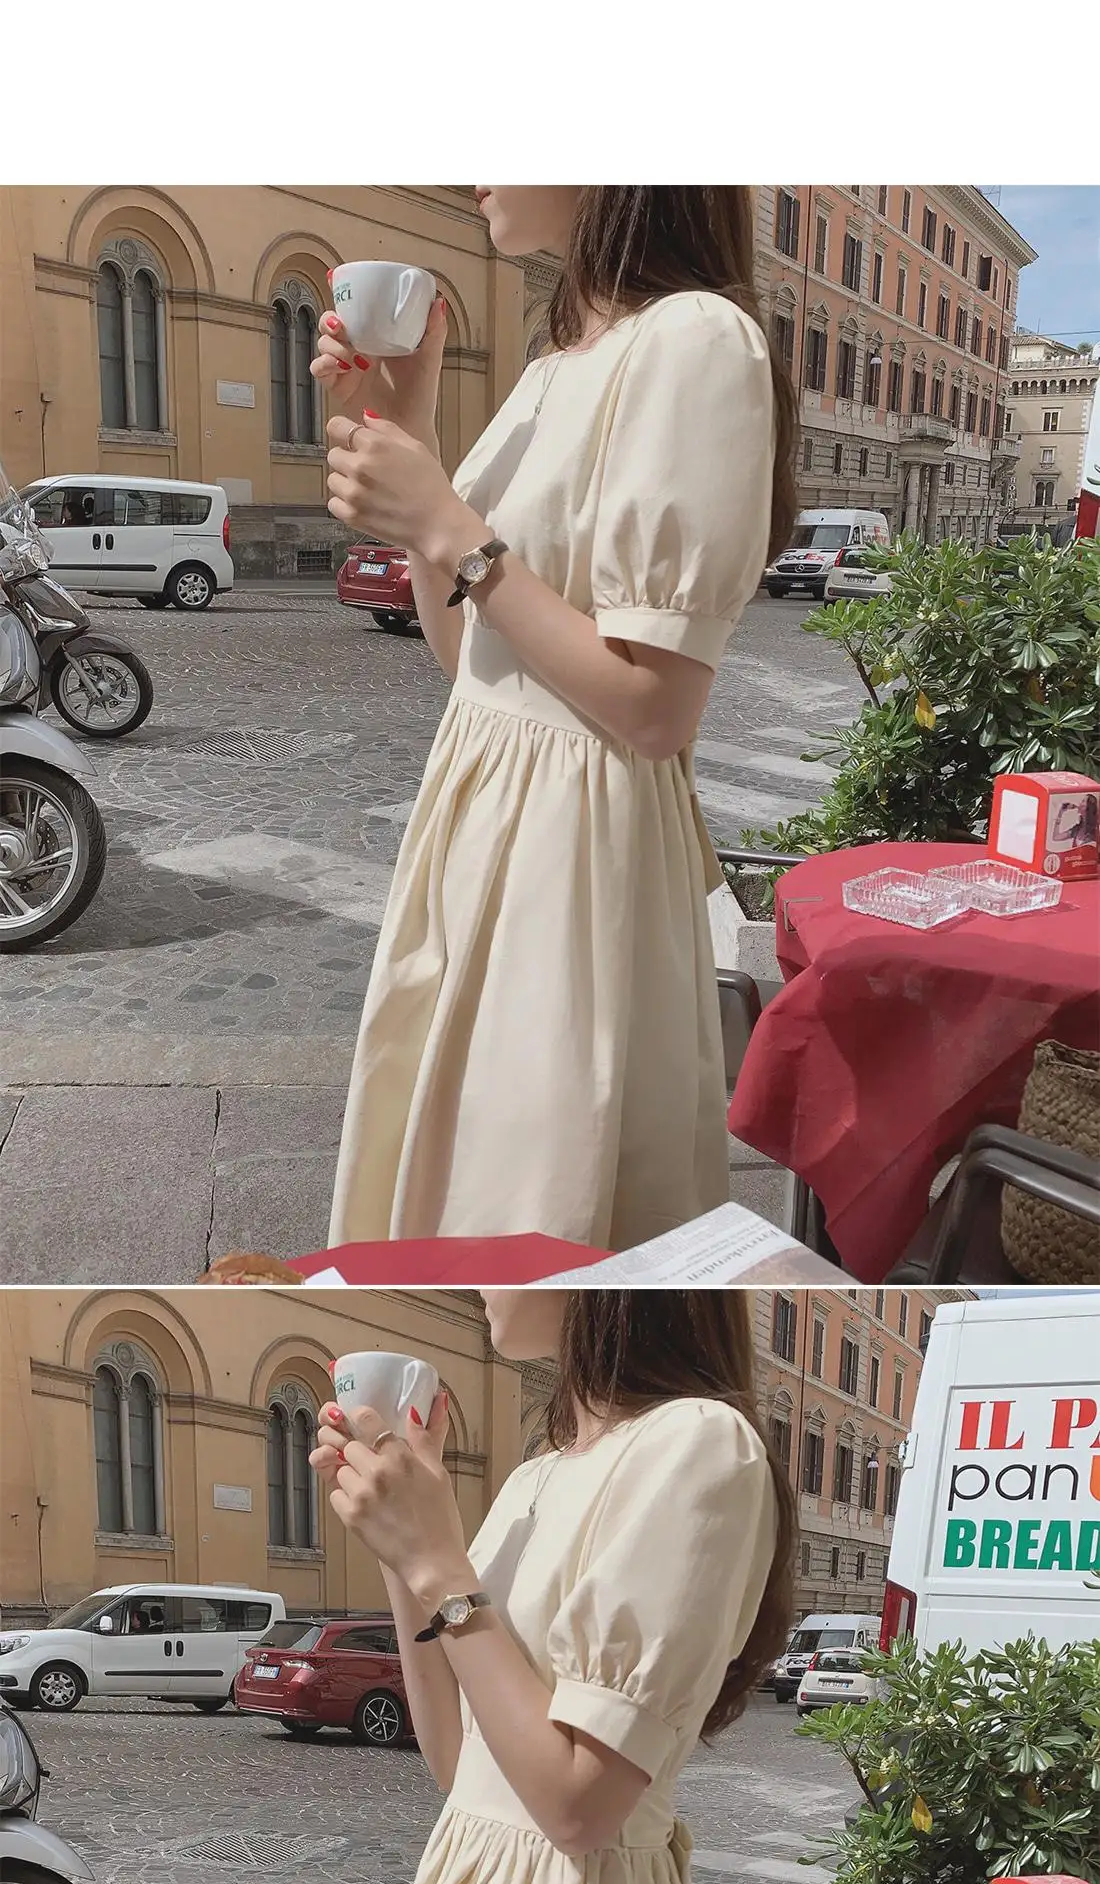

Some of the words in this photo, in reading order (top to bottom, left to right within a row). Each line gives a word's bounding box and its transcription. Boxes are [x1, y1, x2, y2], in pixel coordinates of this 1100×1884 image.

[955, 1400, 1025, 1450] IL
[1046, 1398, 1100, 1449] P
[943, 1519, 1100, 1571] BREAD
